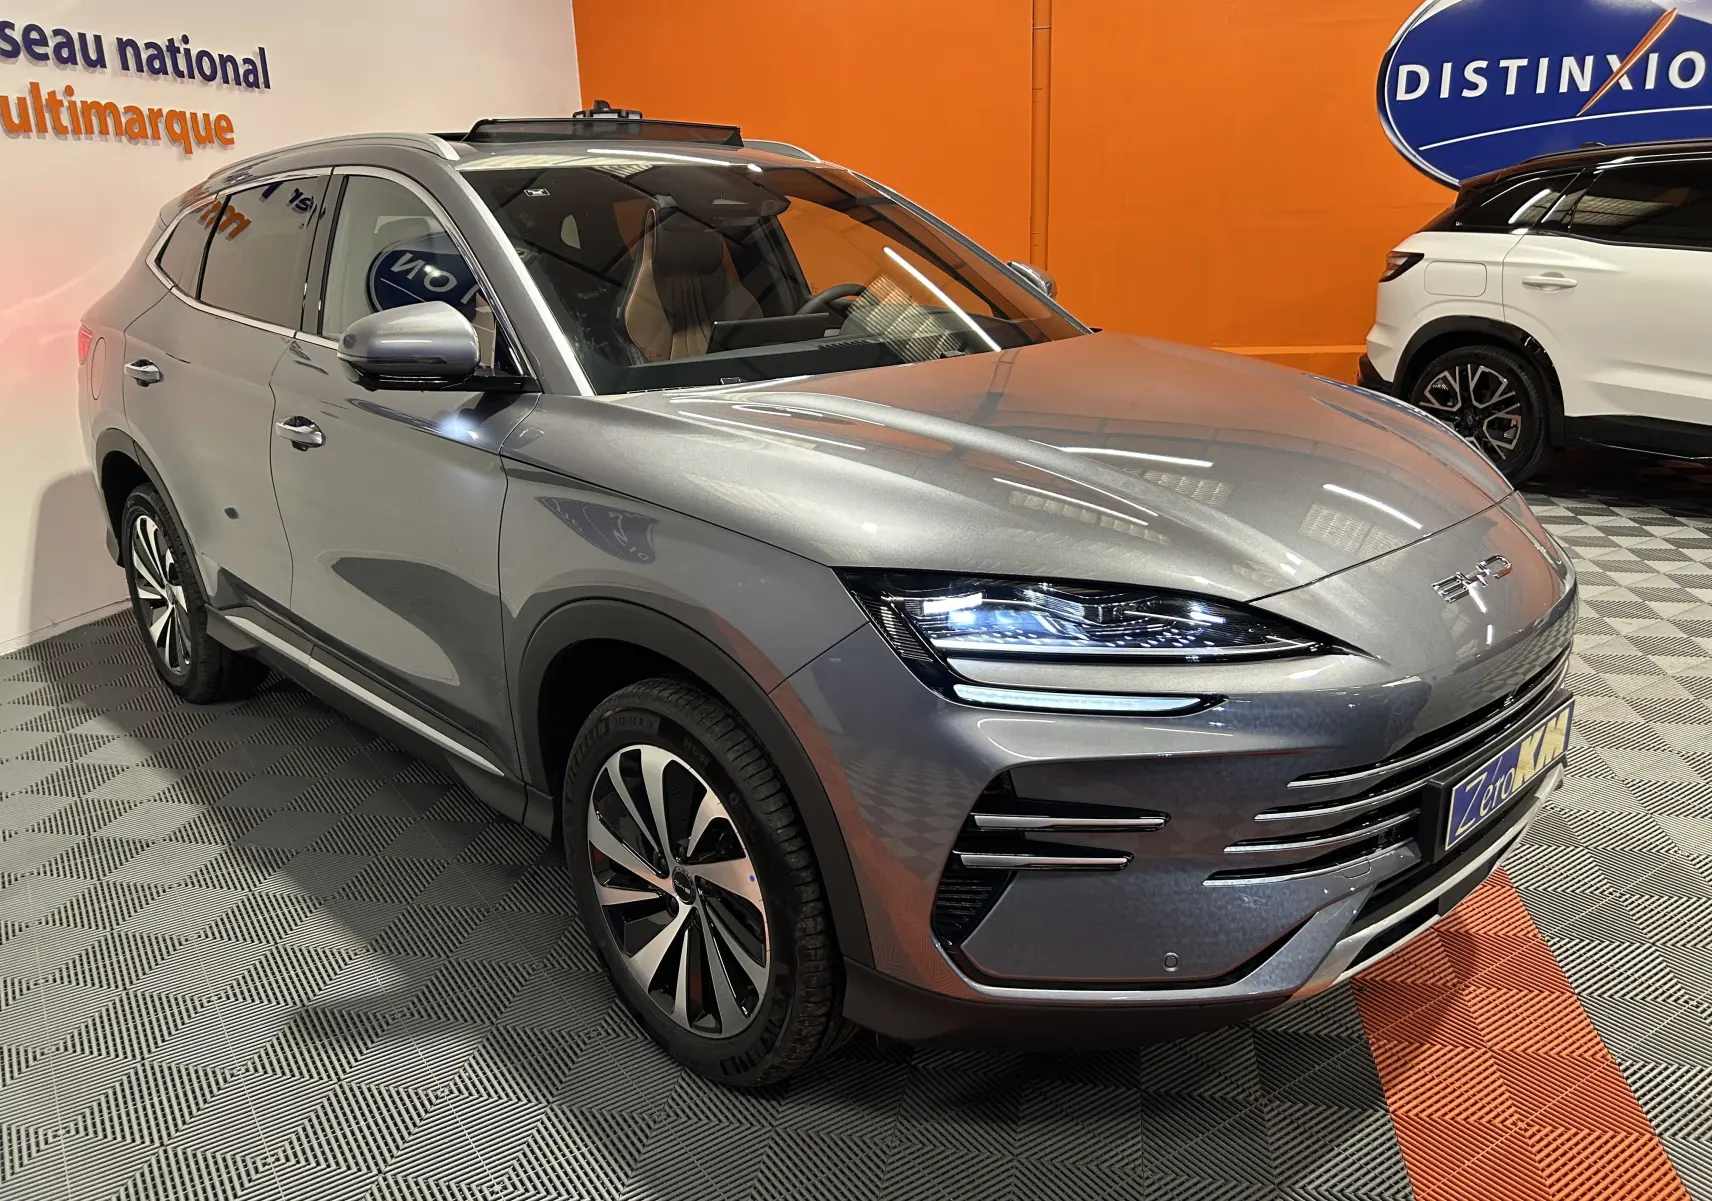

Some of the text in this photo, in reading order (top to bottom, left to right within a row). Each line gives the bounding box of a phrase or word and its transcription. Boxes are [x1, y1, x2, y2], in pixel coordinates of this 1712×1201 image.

[0, 20, 271, 90] seau national
[0, 81, 235, 155] ultimarque
[1431, 554, 1512, 604] BYD
